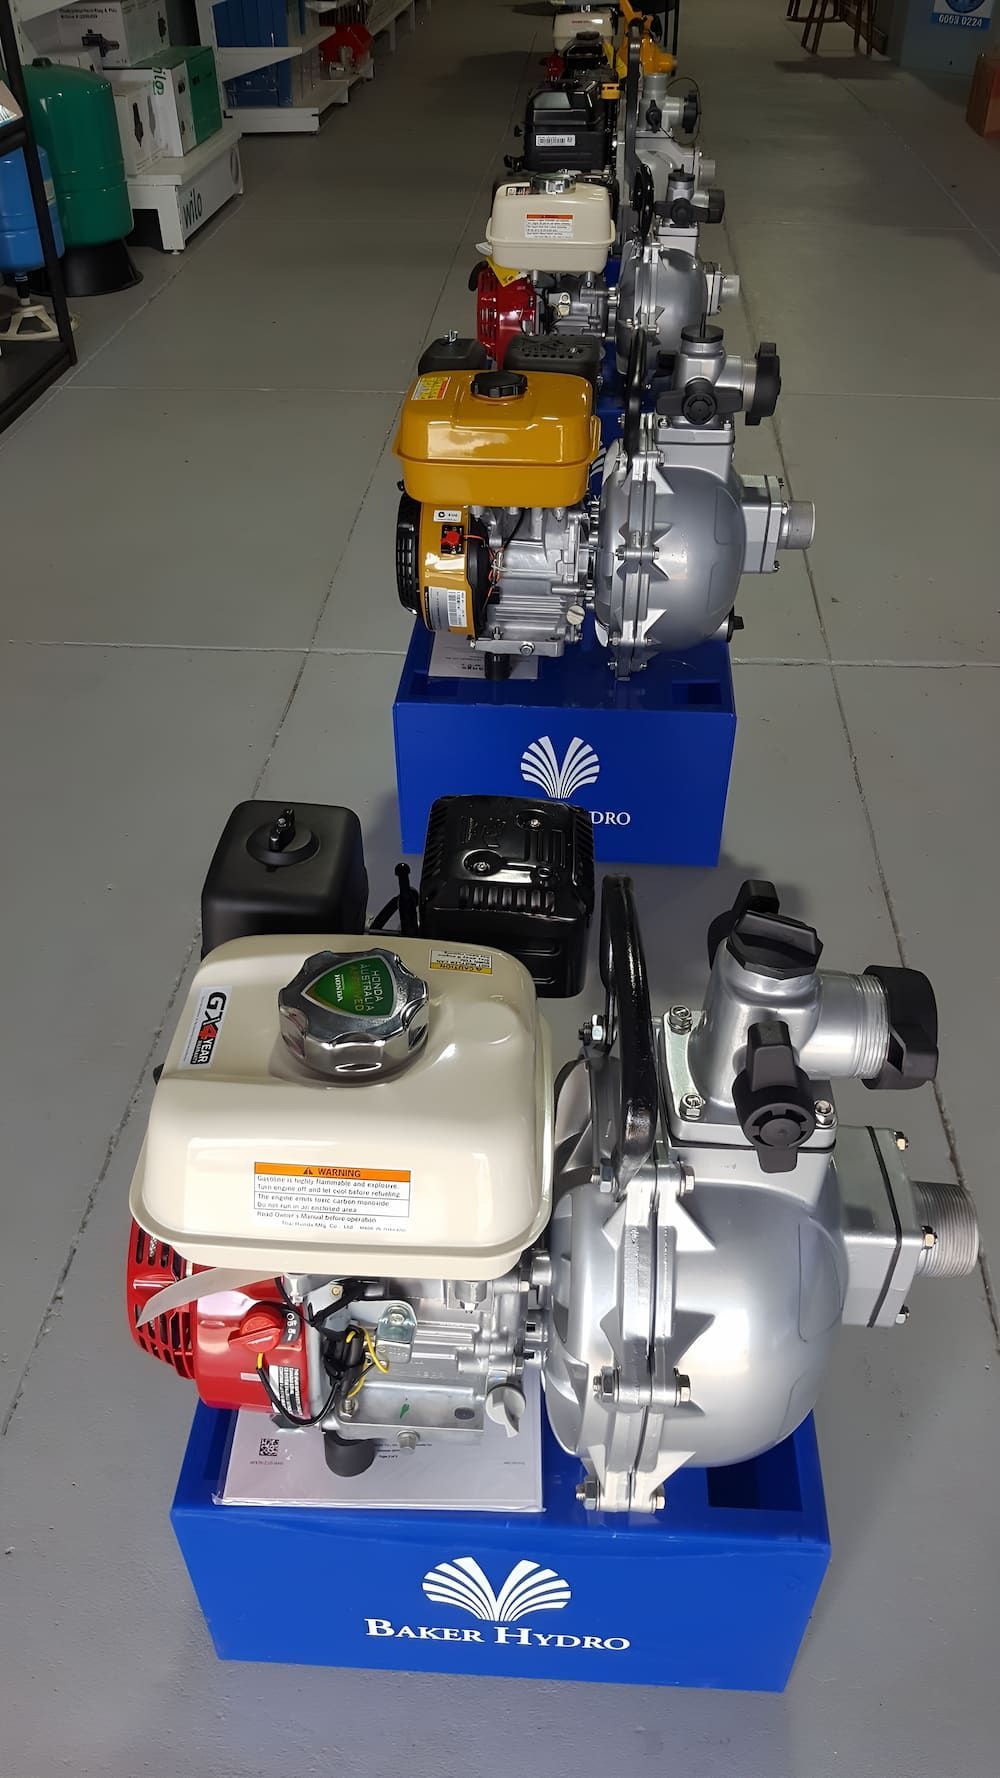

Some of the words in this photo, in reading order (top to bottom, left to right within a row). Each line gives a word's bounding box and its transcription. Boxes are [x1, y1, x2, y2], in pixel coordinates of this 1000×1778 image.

[962, 16, 982, 27] 0224
[182, 187, 203, 229] wilo
[588, 810, 631, 826] DRO
[334, 974, 344, 1002] HONDA
[360, 964, 375, 1011] AUSTRALIA
[371, 970, 384, 1002] HONDA
[200, 992, 227, 1031] GX
[198, 1038, 214, 1063] YEAR
[257, 1175, 286, 1183] Gasoline
[316, 1178, 351, 1186] flammable
[318, 1168, 361, 1178] WARNING
[315, 1196, 331, 1204] toxic
[364, 1618, 486, 1643] BAKER
[494, 1626, 632, 1651] HYDRO
